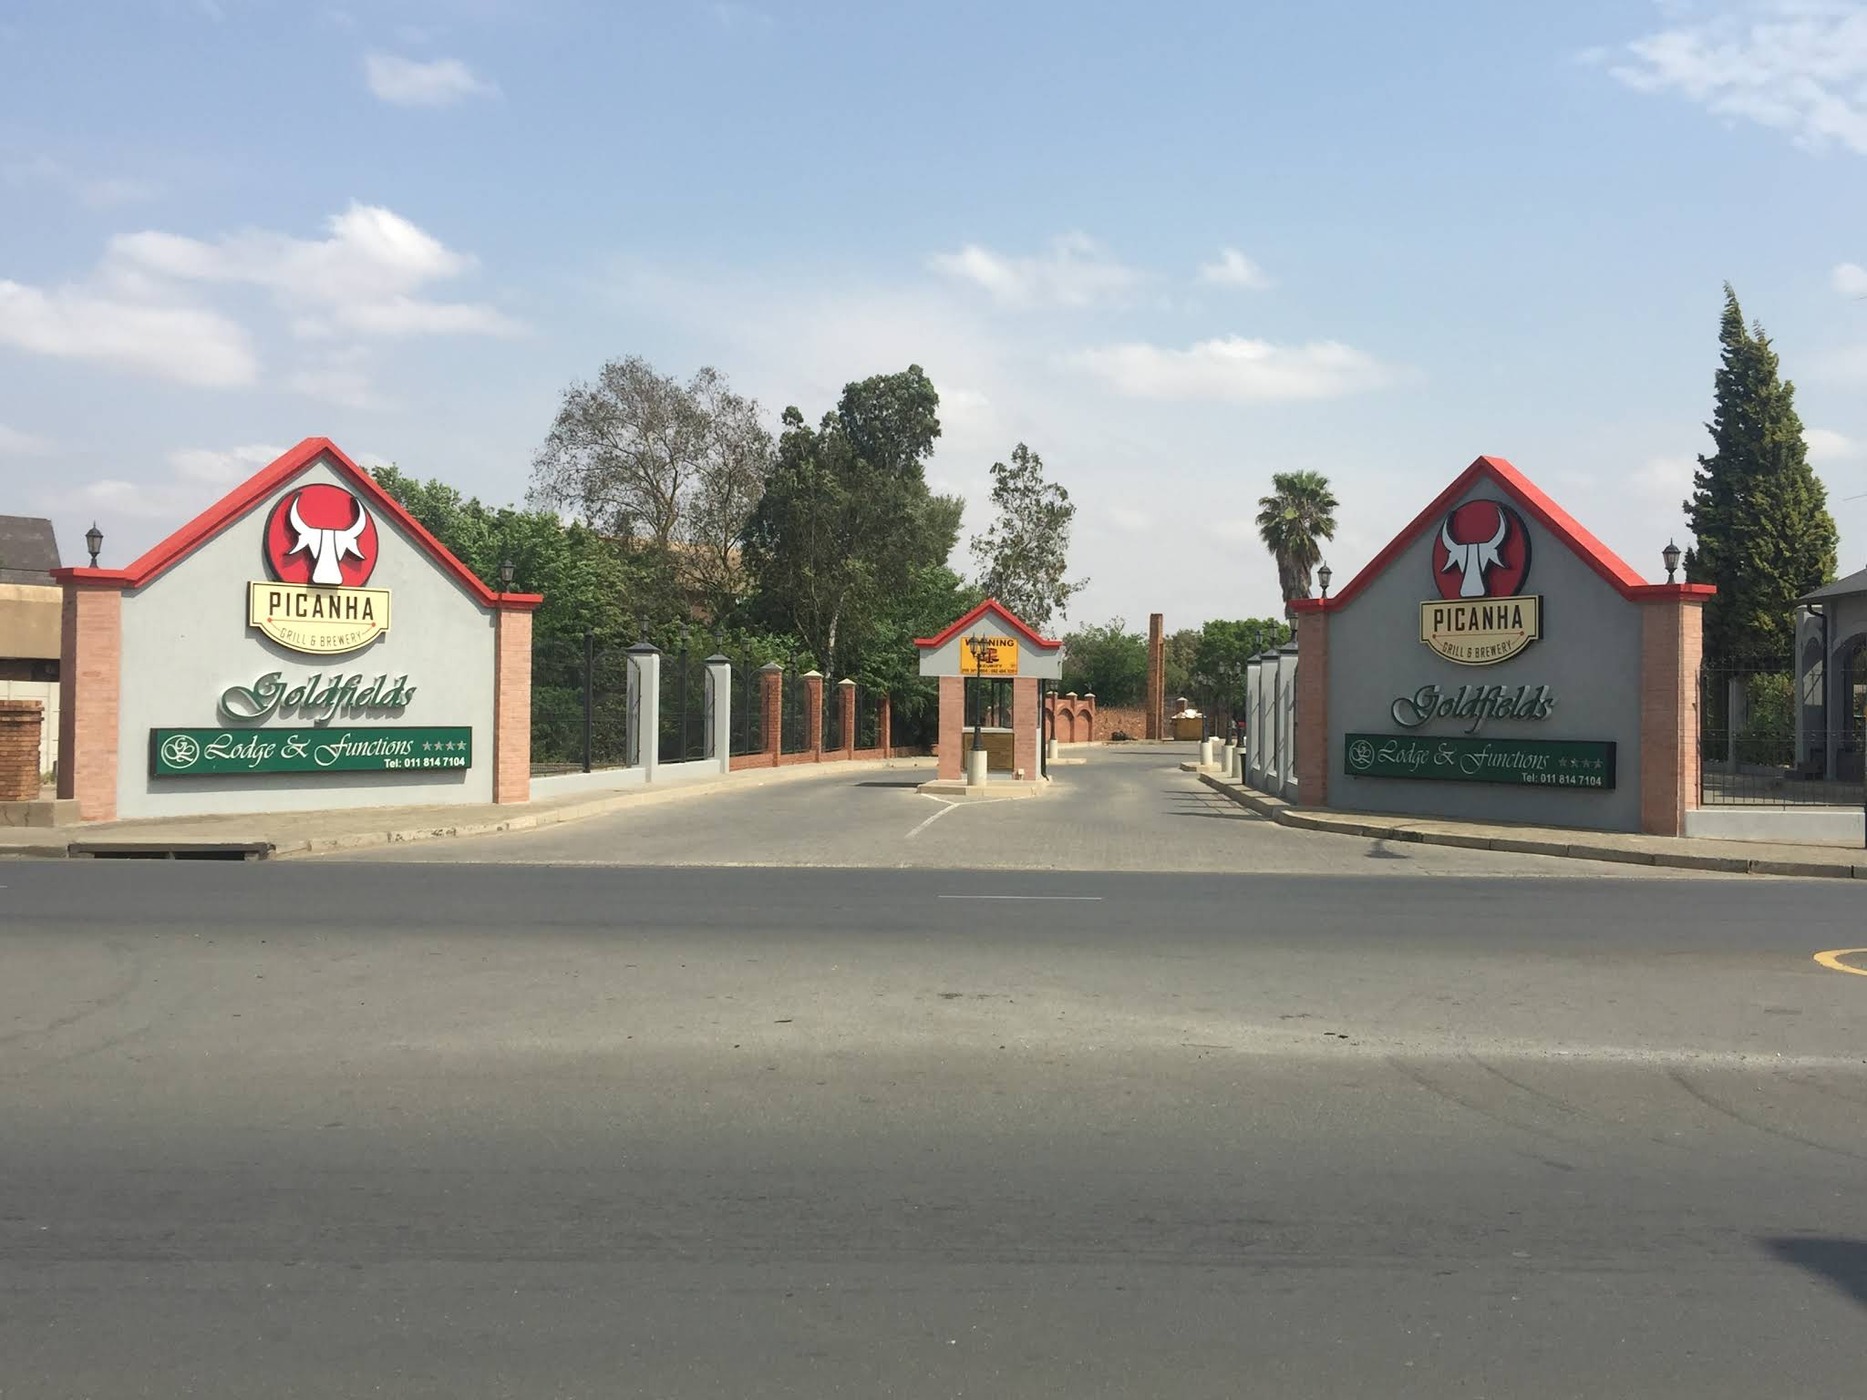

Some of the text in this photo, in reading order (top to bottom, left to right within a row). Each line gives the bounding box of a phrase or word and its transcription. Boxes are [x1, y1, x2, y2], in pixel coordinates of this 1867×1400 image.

[269, 592, 374, 620] PICANHA
[1434, 605, 1523, 632] PICANHA
[280, 627, 306, 645] GRILL
[320, 631, 361, 647] BREWERY
[965, 639, 1015, 647] WNING
[1442, 641, 1464, 657] GRILL
[1475, 640, 1512, 658] BREWERY
[220, 671, 417, 722] Goldfields
[1391, 684, 1557, 734] Goldfields
[204, 733, 414, 767] Lodge & Functions
[384, 757, 465, 768] Tel: 011 814 7104
[1378, 740, 1549, 774] Lodge & Functions
[1522, 773, 1602, 786] Tel: 011 814 7104
